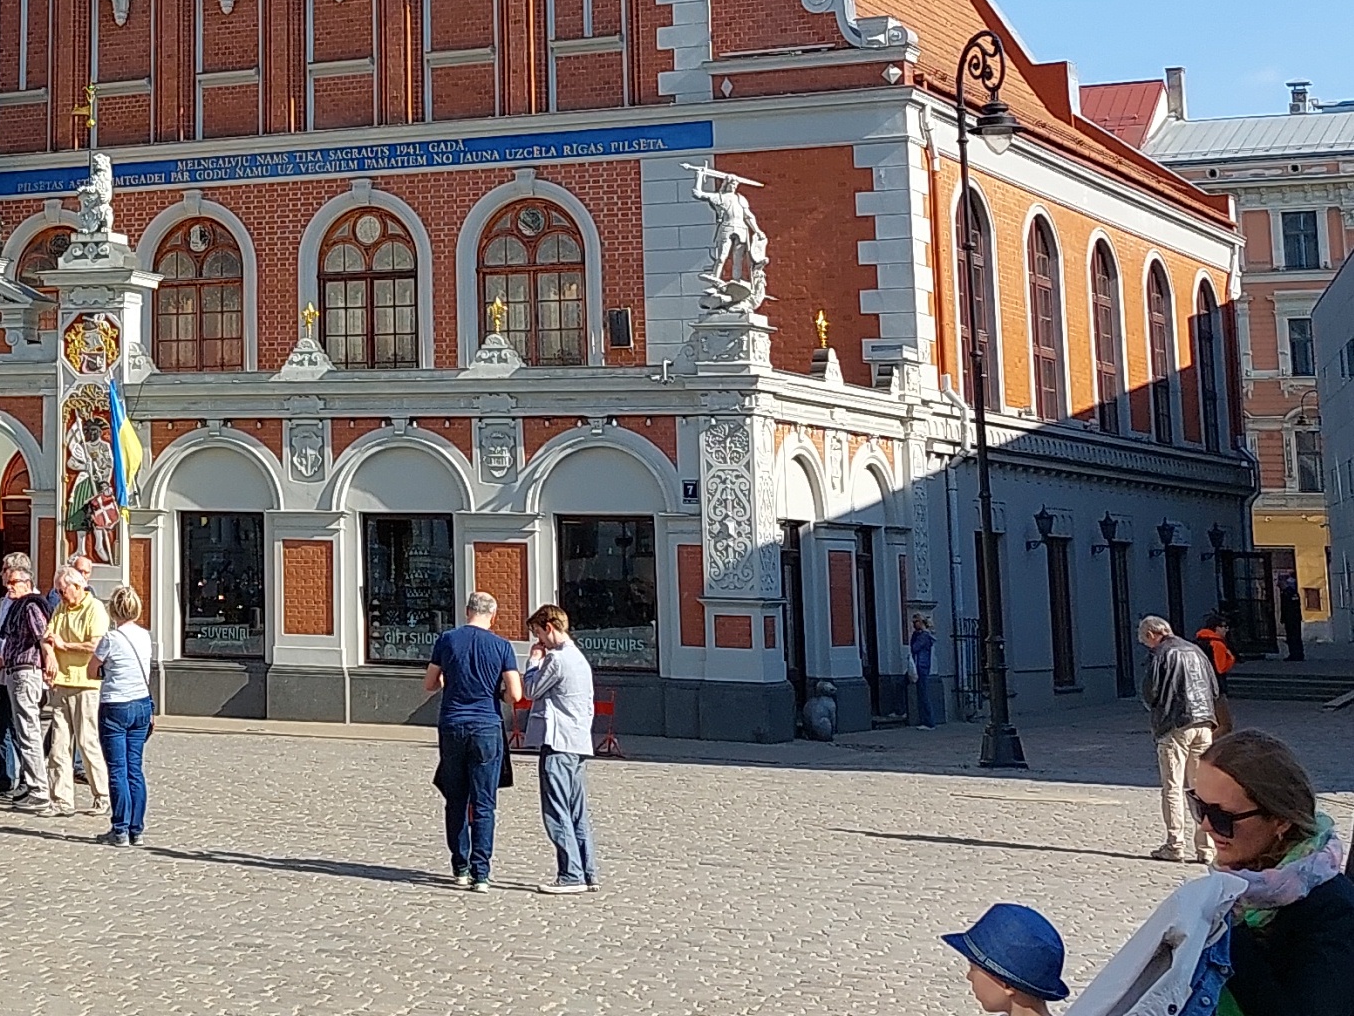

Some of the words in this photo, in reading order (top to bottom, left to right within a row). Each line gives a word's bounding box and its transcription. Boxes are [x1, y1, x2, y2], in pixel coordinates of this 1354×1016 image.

[256, 153, 288, 165] NAMS
[293, 151, 323, 162] TIKA
[329, 146, 389, 160] SAGRAUTS
[396, 144, 424, 155] 1941.
[196, 168, 231, 180] GODU
[235, 165, 271, 178] NAMU
[277, 164, 294, 175] UZ
[299, 159, 358, 173] VECAJIEM
[364, 155, 426, 169] PAMATIEM
[432, 153, 453, 164] NO
[686, 485, 694, 495] 7
[384, 629, 407, 644] GIFT
[409, 632, 440, 645] SHOP
[576, 637, 645, 652] SOUVENIRS
